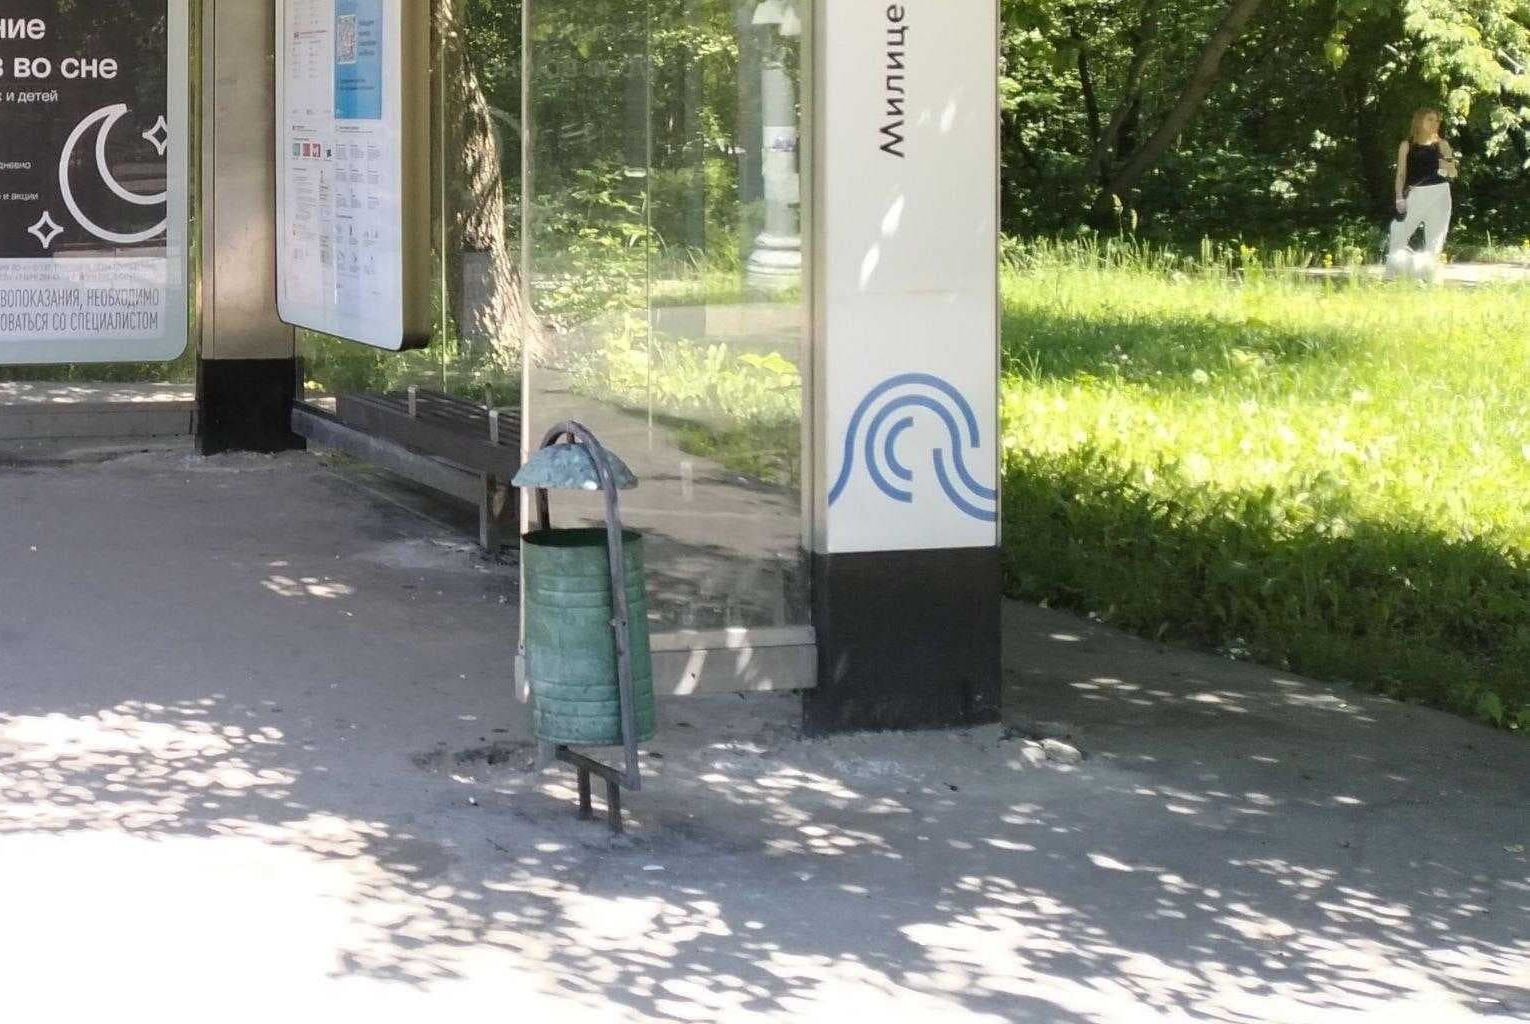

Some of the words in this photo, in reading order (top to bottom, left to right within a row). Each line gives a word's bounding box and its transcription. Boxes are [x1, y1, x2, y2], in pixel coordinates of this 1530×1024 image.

[13, 56, 52, 78] во
[60, 57, 118, 79] сне
[6, 91, 15, 102] и
[17, 89, 58, 103] детей
[11, 192, 38, 202] акции
[86, 287, 160, 308] НЕОБХОДИМО
[52, 312, 67, 331] СО
[70, 311, 159, 332] СПЕЦИАЛИСТОМ
